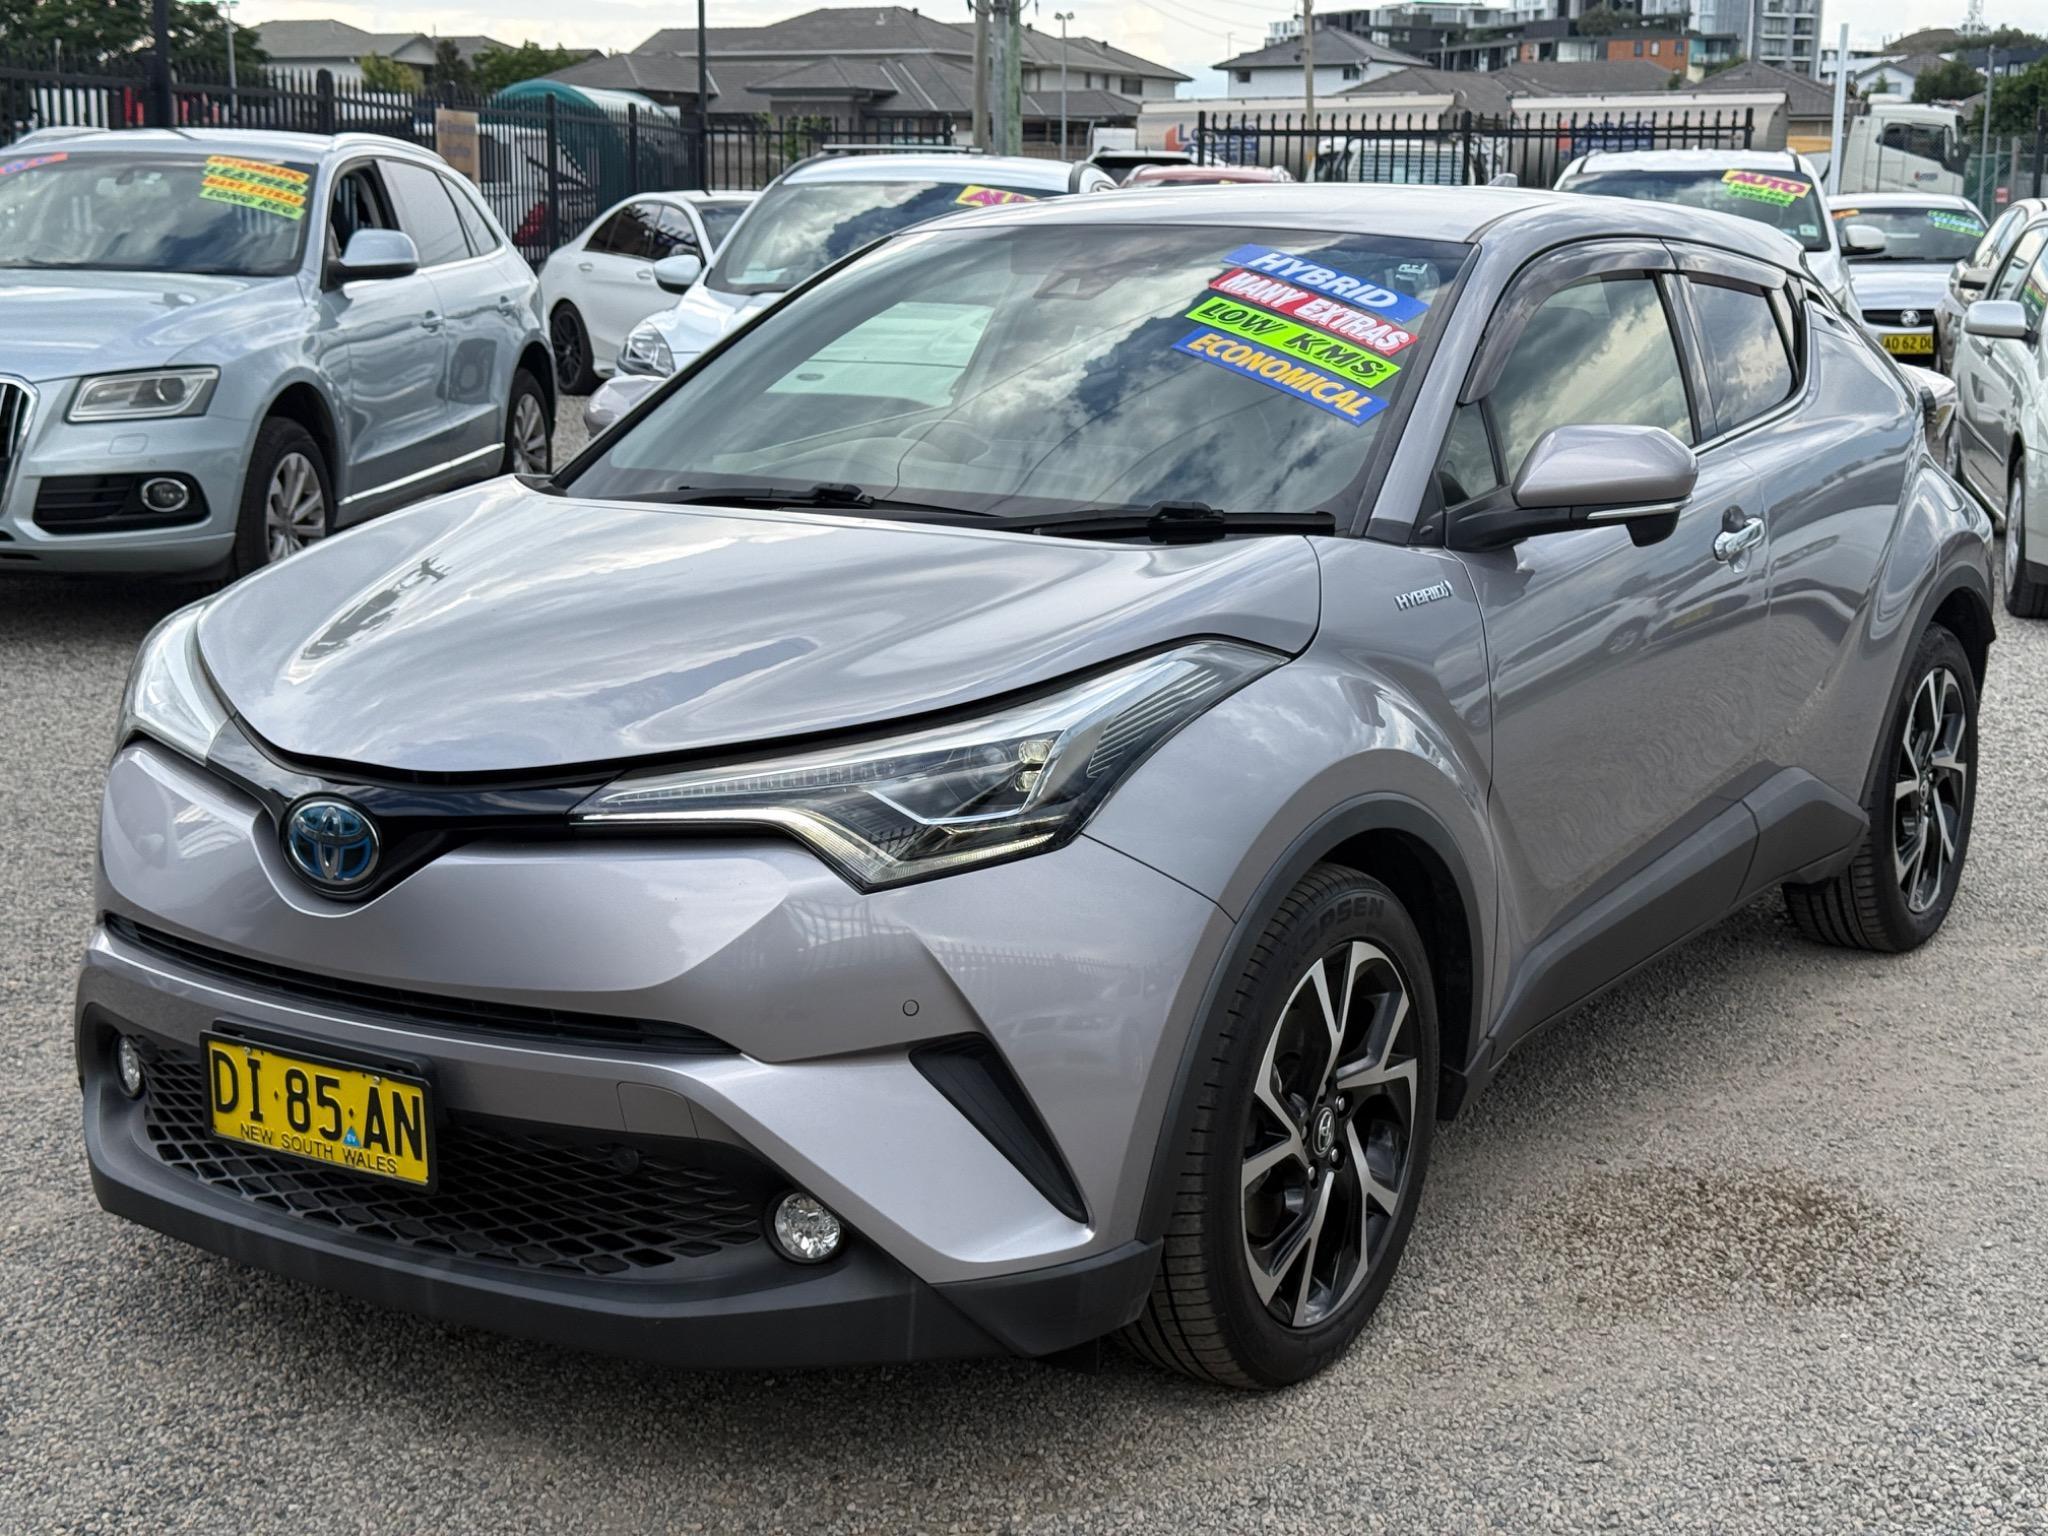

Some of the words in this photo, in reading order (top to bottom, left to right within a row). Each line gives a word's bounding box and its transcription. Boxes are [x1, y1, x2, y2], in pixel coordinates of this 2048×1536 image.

[207, 189, 254, 203] LONG
[259, 201, 297, 214] REG
[1726, 173, 1806, 193] AUTO
[1247, 252, 1398, 308] HYBRID
[1219, 271, 1308, 307] MANY
[1293, 297, 1410, 350] EXTRAS
[1197, 302, 1288, 335] LOW
[1285, 333, 1388, 379] KMS
[1902, 336, 1917, 350] 62
[1187, 333, 1372, 417] ECONOMICAL
[1394, 584, 1446, 610] HYBRID
[211, 1050, 264, 1123] DI
[285, 1067, 343, 1142] 85
[362, 1085, 424, 1163] AN
[239, 1122, 275, 1146] NEW
[280, 1133, 334, 1161] SOUTH
[342, 1147, 398, 1175] WALES
